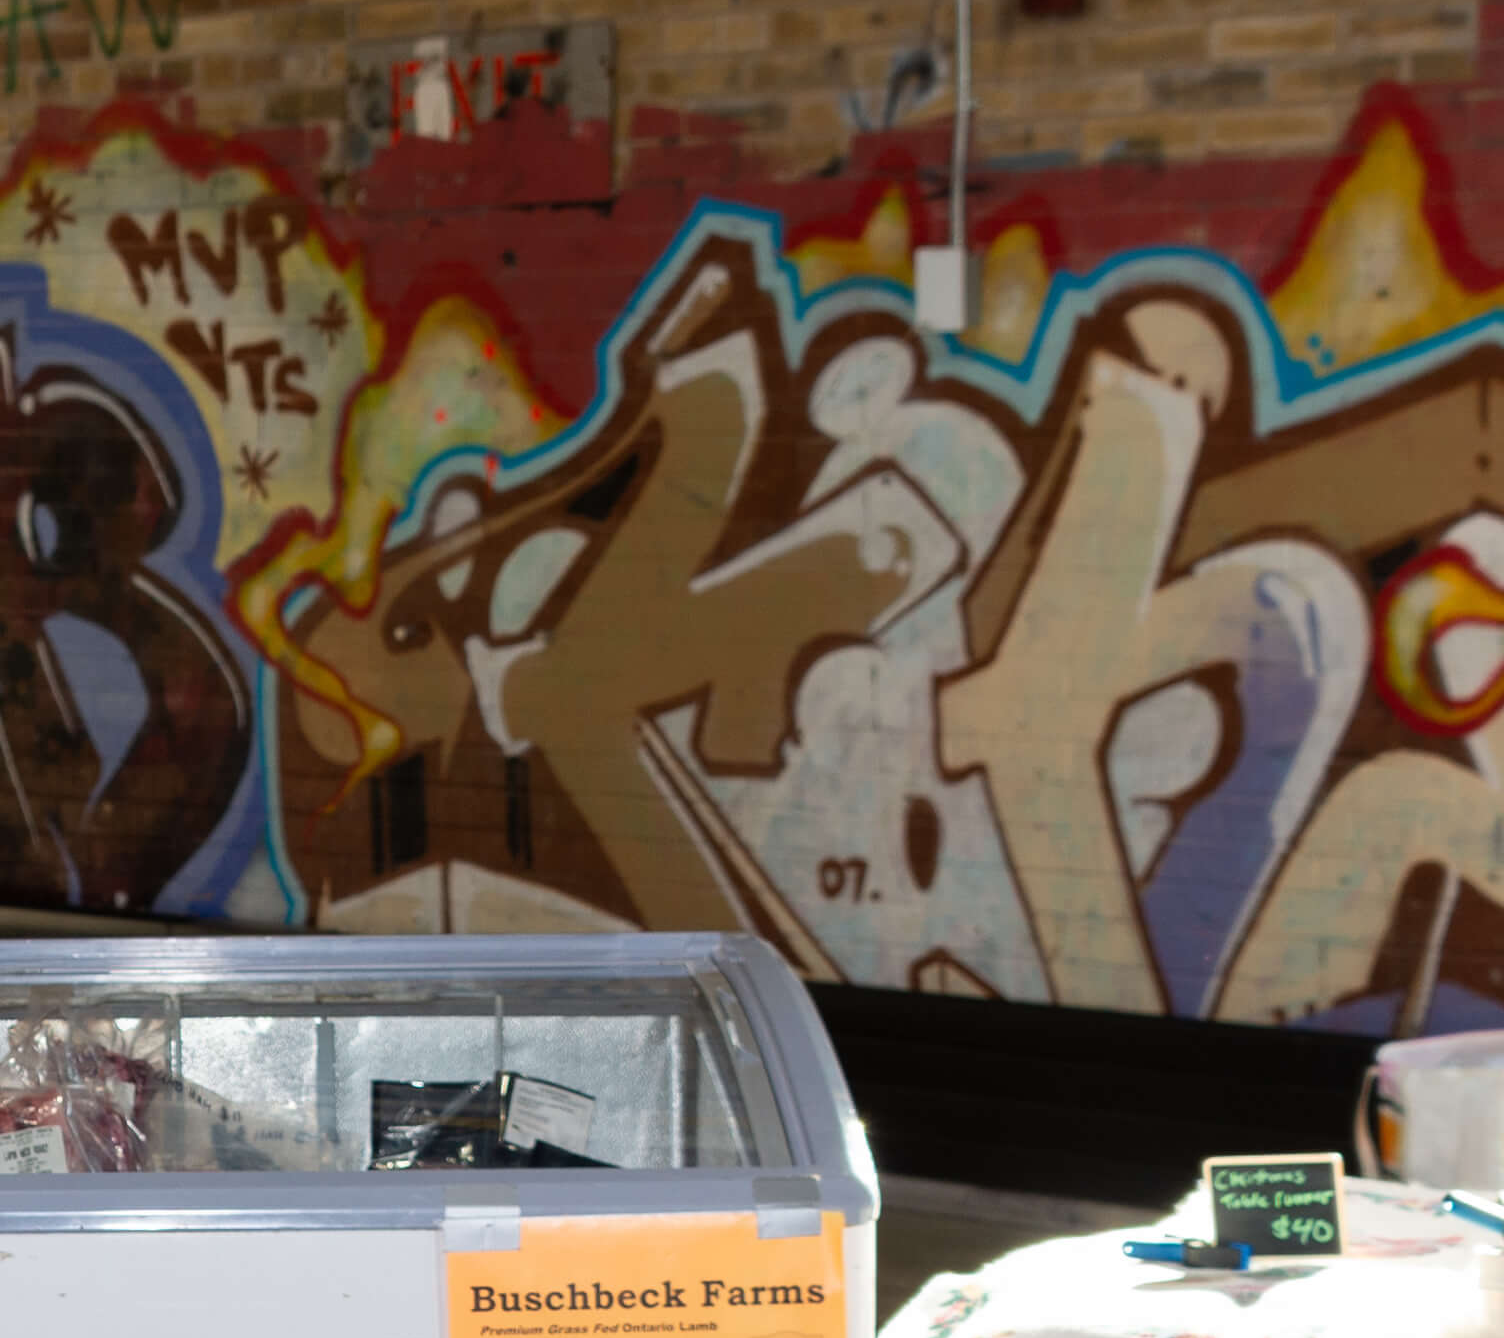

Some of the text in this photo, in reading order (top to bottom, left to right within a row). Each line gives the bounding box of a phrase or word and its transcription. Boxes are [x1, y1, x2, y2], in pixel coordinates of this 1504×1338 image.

[106, 195, 308, 314] MVP
[1270, 1213, 1334, 1246] $40
[469, 1279, 826, 1314] Buschbeck Farms
[480, 1321, 718, 1337] Premium Grass Fed Ontario Lamb
